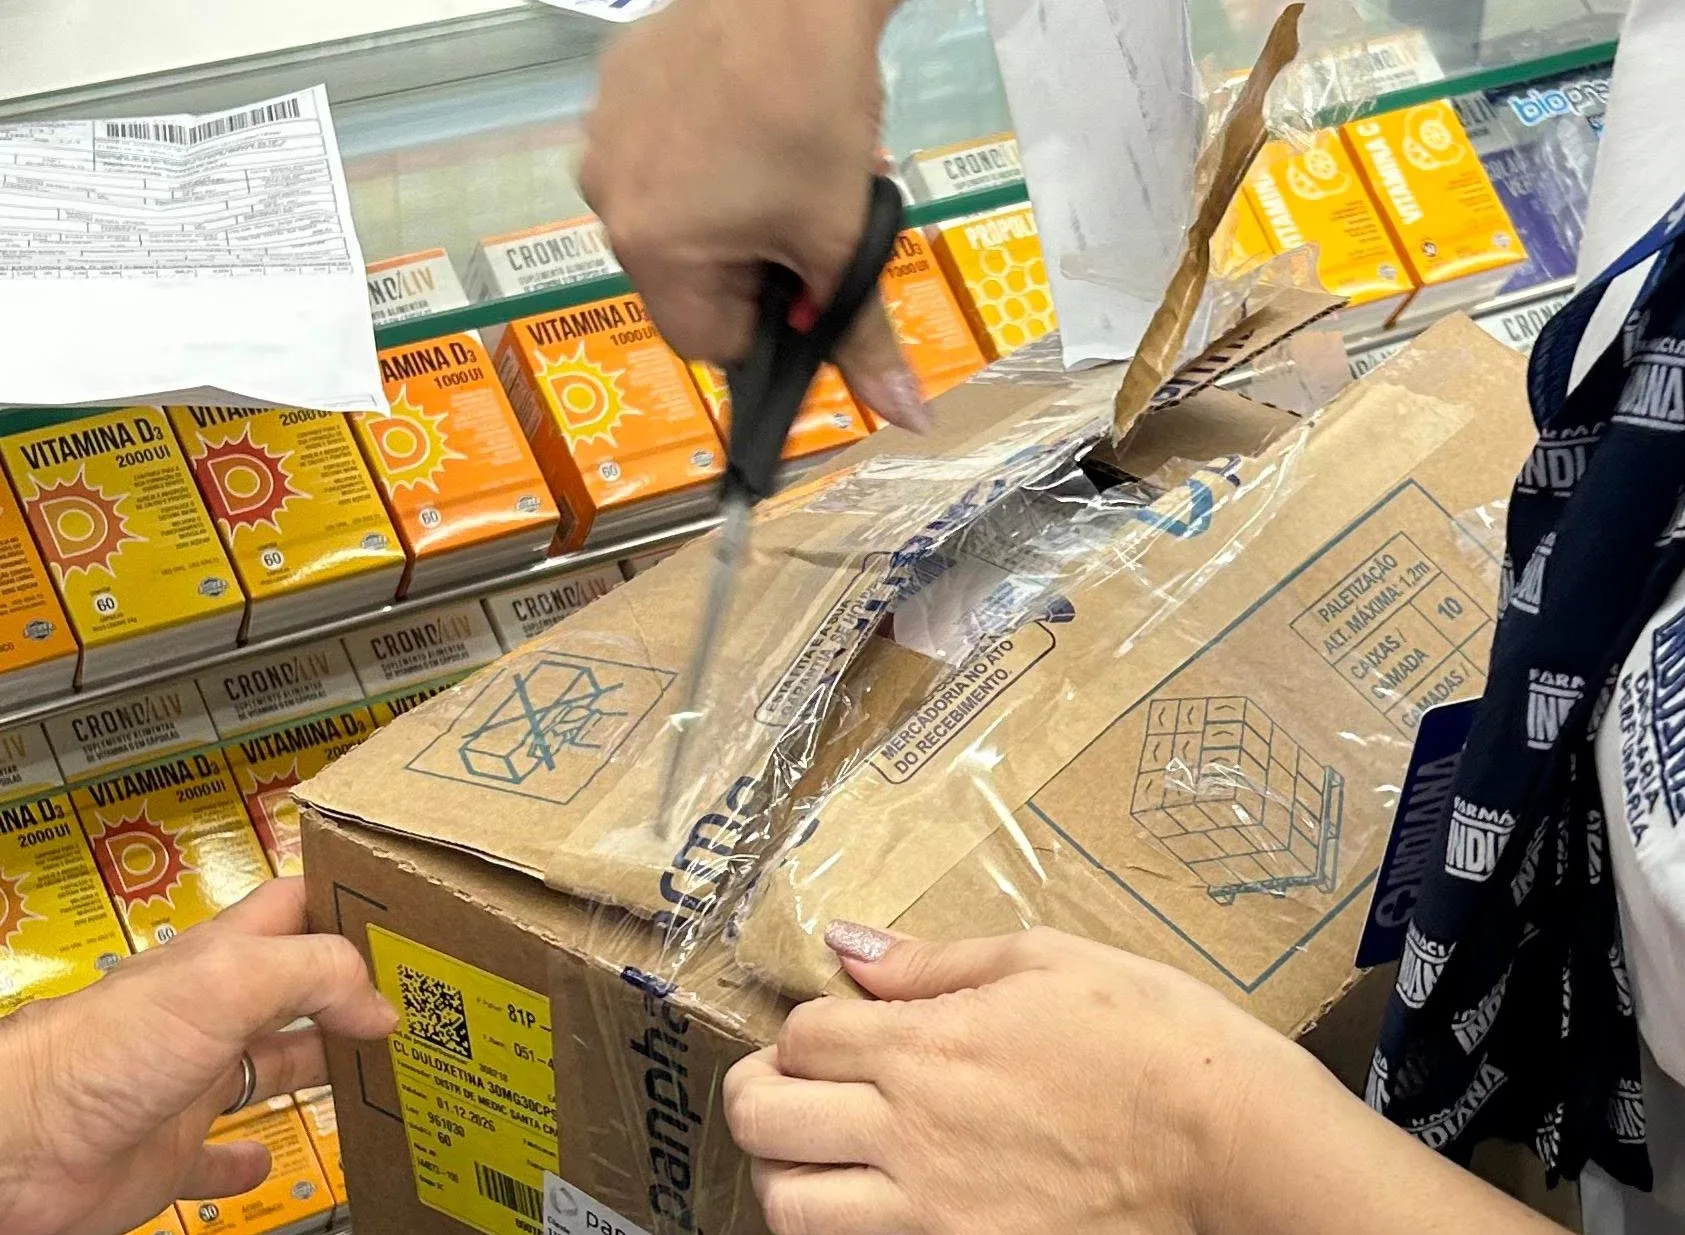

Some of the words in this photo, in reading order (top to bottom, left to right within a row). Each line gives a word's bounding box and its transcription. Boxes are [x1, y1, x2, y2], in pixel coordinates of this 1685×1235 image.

[526, 304, 626, 346] VITAMINA
[433, 370, 467, 389] 1000
[20, 423, 136, 470] VITAMINA
[115, 452, 156, 469] 2000
[422, 510, 439, 526] 60
[263, 551, 282, 567] 60
[96, 596, 116, 612] 60
[1318, 553, 1398, 623] PALETIZAÇÃO
[1322, 629, 1351, 656] ALT.
[1345, 583, 1404, 634] MÁXIMA:
[1400, 560, 1430, 589] 1,2m
[1437, 596, 1464, 621] 10
[1350, 634, 1401, 680] CAIXAS
[1370, 648, 1429, 700] CAMADA
[881, 677, 966, 761] MERCADORIA
[964, 660, 989, 686] NO
[987, 640, 1014, 666] ATO
[893, 751, 919, 775] DO
[918, 668, 1013, 755] RECEBIMENTO.
[1401, 670, 1465, 729] CAMADAS
[240, 718, 342, 764] VITAMINA
[88, 760, 194, 807] VITAMINA
[176, 784, 210, 803] 2000
[17, 827, 55, 848] 2000
[157, 926, 174, 943] 60
[507, 1003, 536, 1029] 81P
[393, 1039, 410, 1057] CL
[411, 1047, 486, 1090] DULOXETINA
